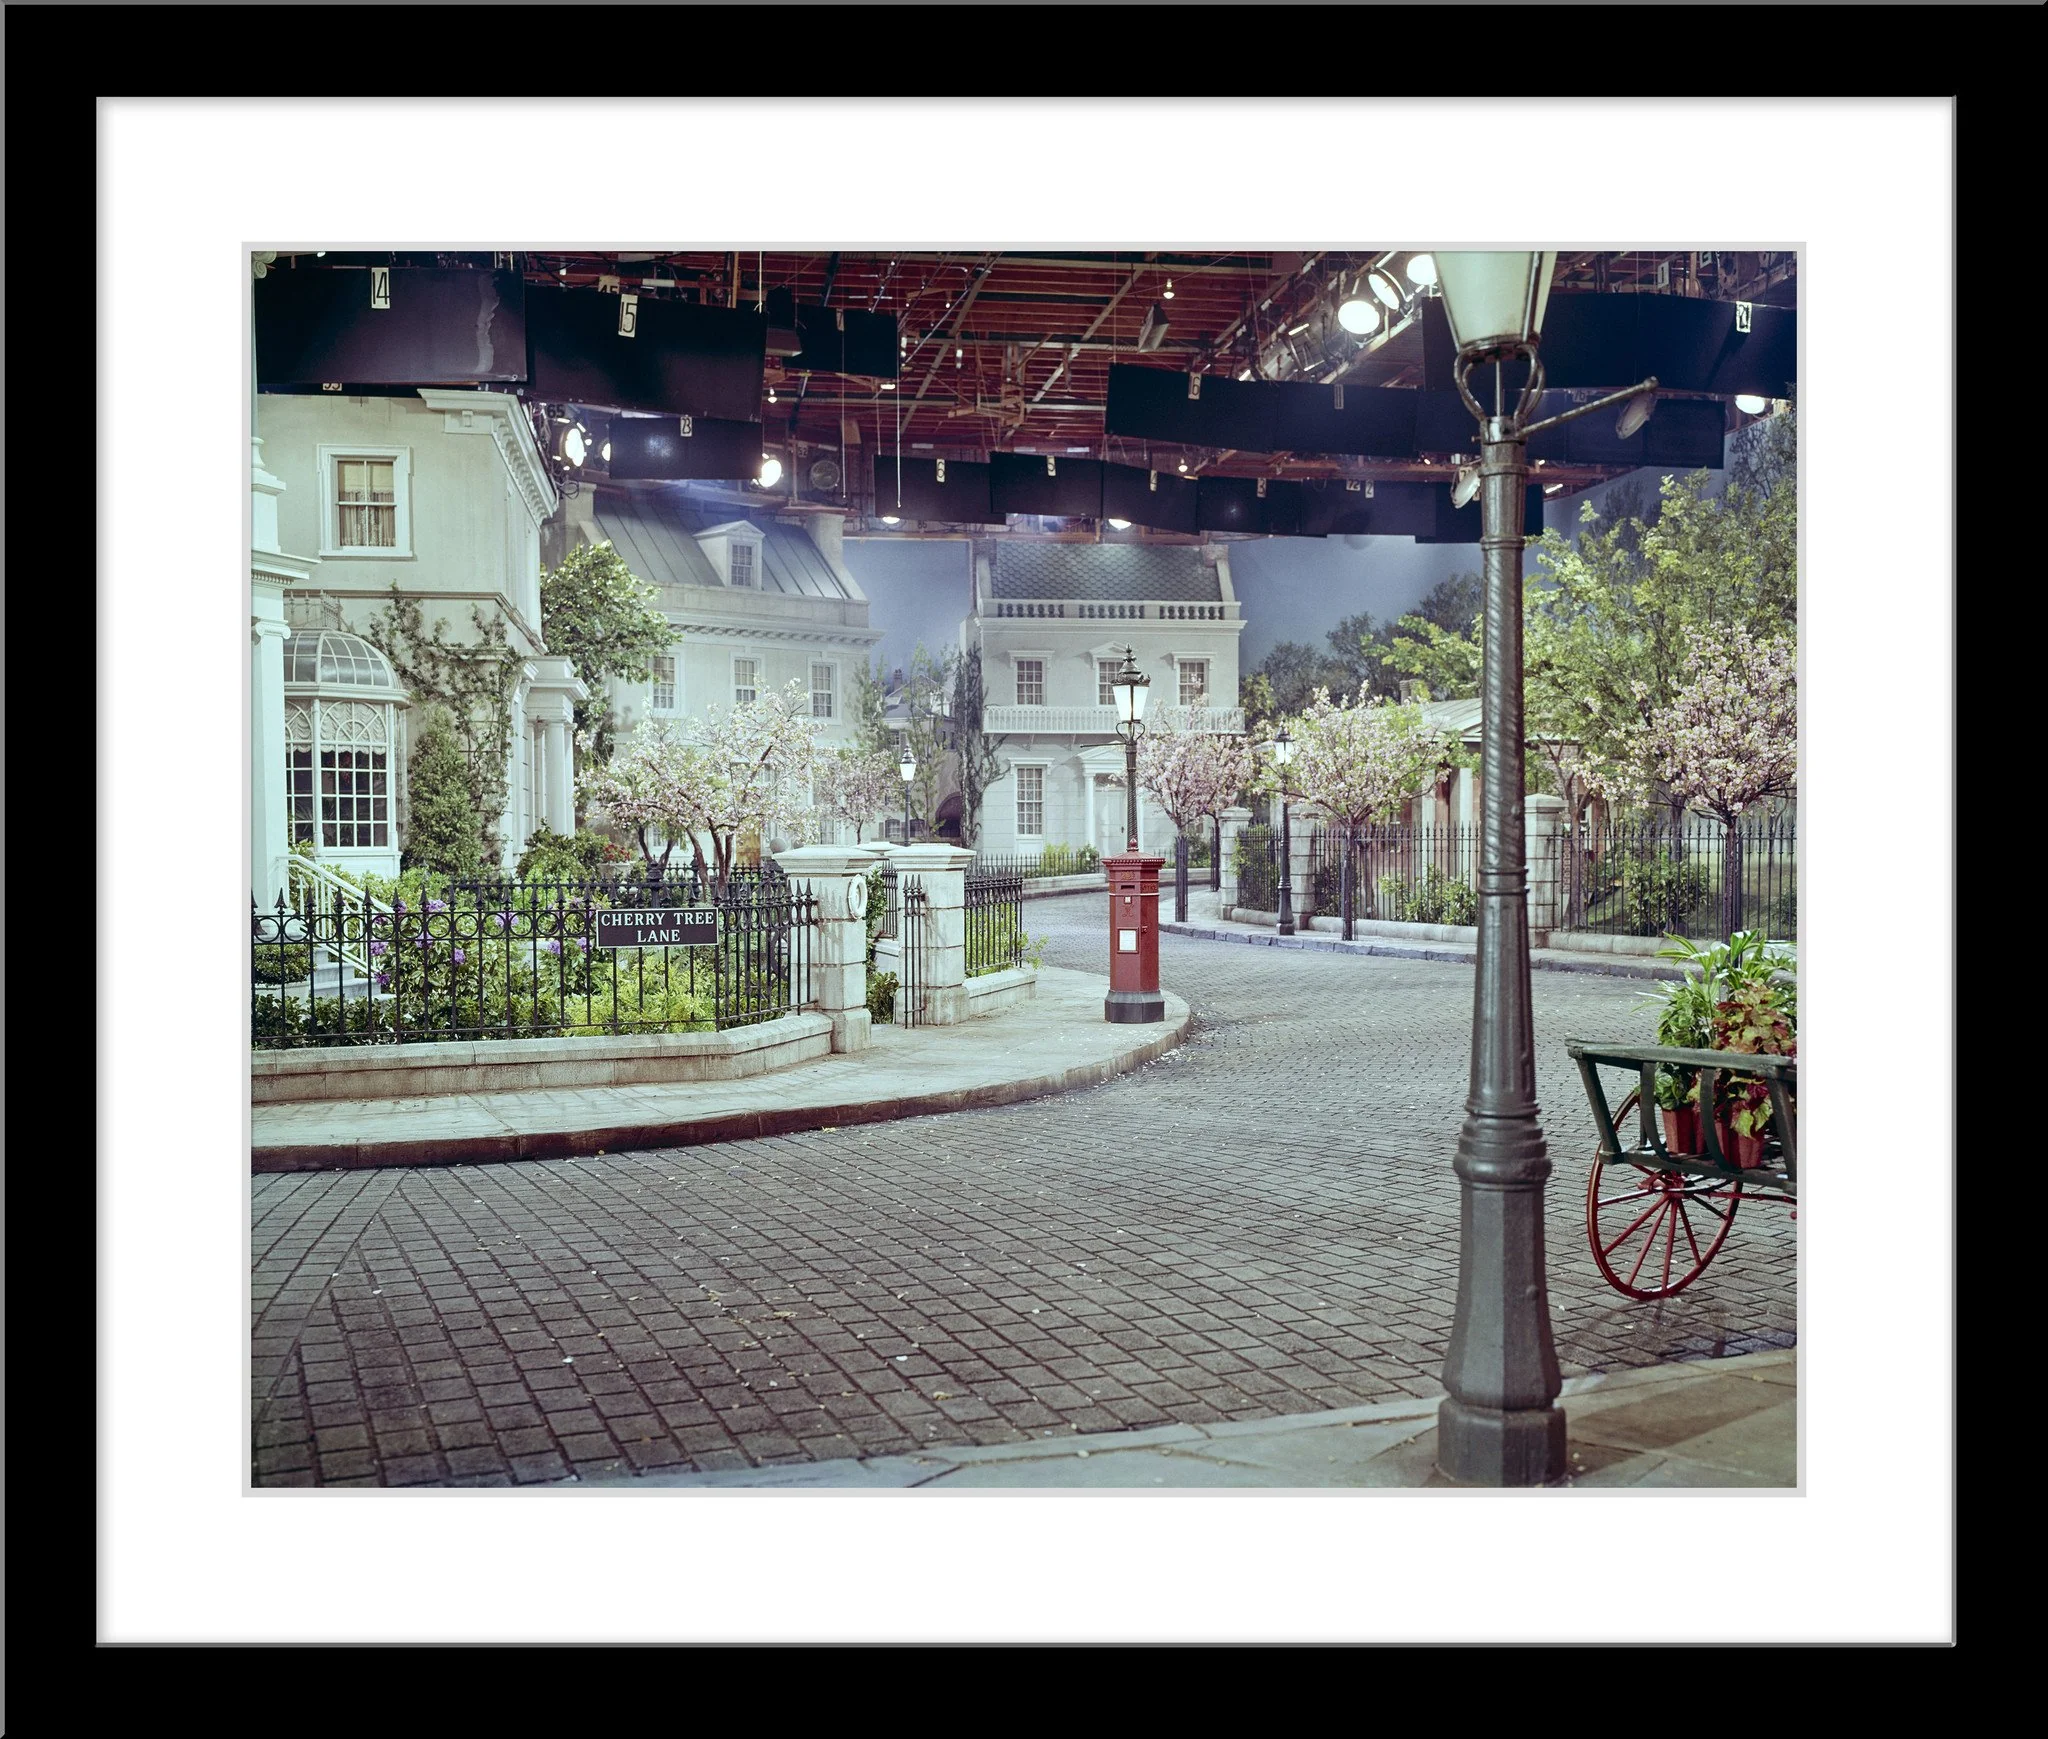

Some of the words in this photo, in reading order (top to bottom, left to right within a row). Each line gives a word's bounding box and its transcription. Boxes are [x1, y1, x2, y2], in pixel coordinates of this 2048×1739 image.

[372, 271, 390, 305] 14
[619, 301, 638, 333] 15
[546, 403, 564, 419] 65
[937, 461, 944, 478] 6
[1257, 478, 1265, 494] 3
[601, 913, 665, 926] CHERRY
[673, 912, 714, 925] TREE
[637, 929, 681, 943] LANE
